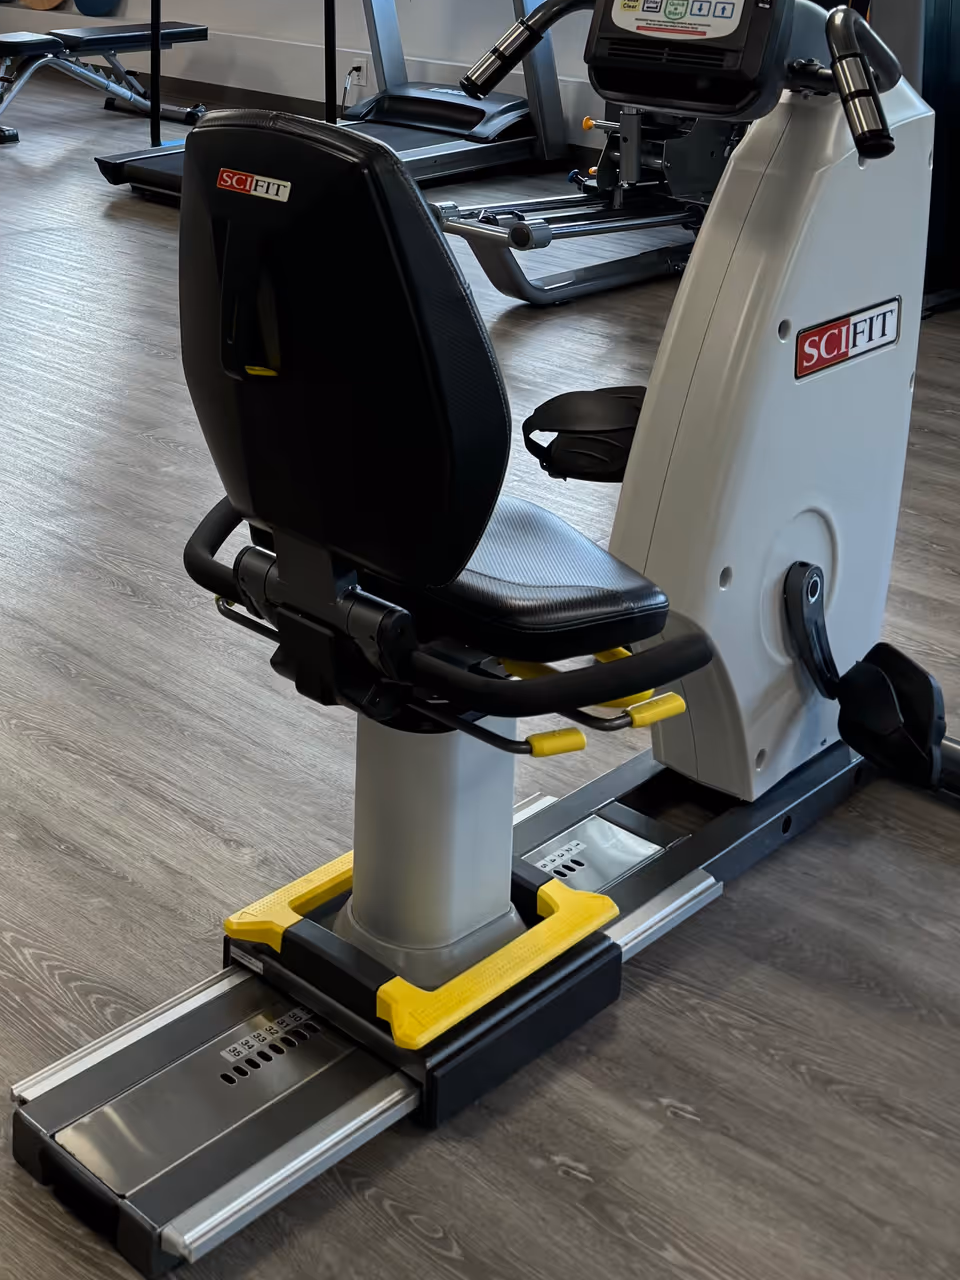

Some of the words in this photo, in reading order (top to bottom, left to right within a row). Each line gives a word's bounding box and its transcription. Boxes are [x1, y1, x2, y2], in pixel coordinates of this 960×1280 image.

[220, 172, 288, 197] SCIFIT
[803, 308, 896, 367] SCIFIT
[288, 1011, 303, 1023] 30
[276, 1018, 290, 1029] 31
[264, 1025, 279, 1036] 32
[252, 1032, 267, 1043] 33
[240, 1039, 255, 1050] 34
[228, 1046, 243, 1057] 35
